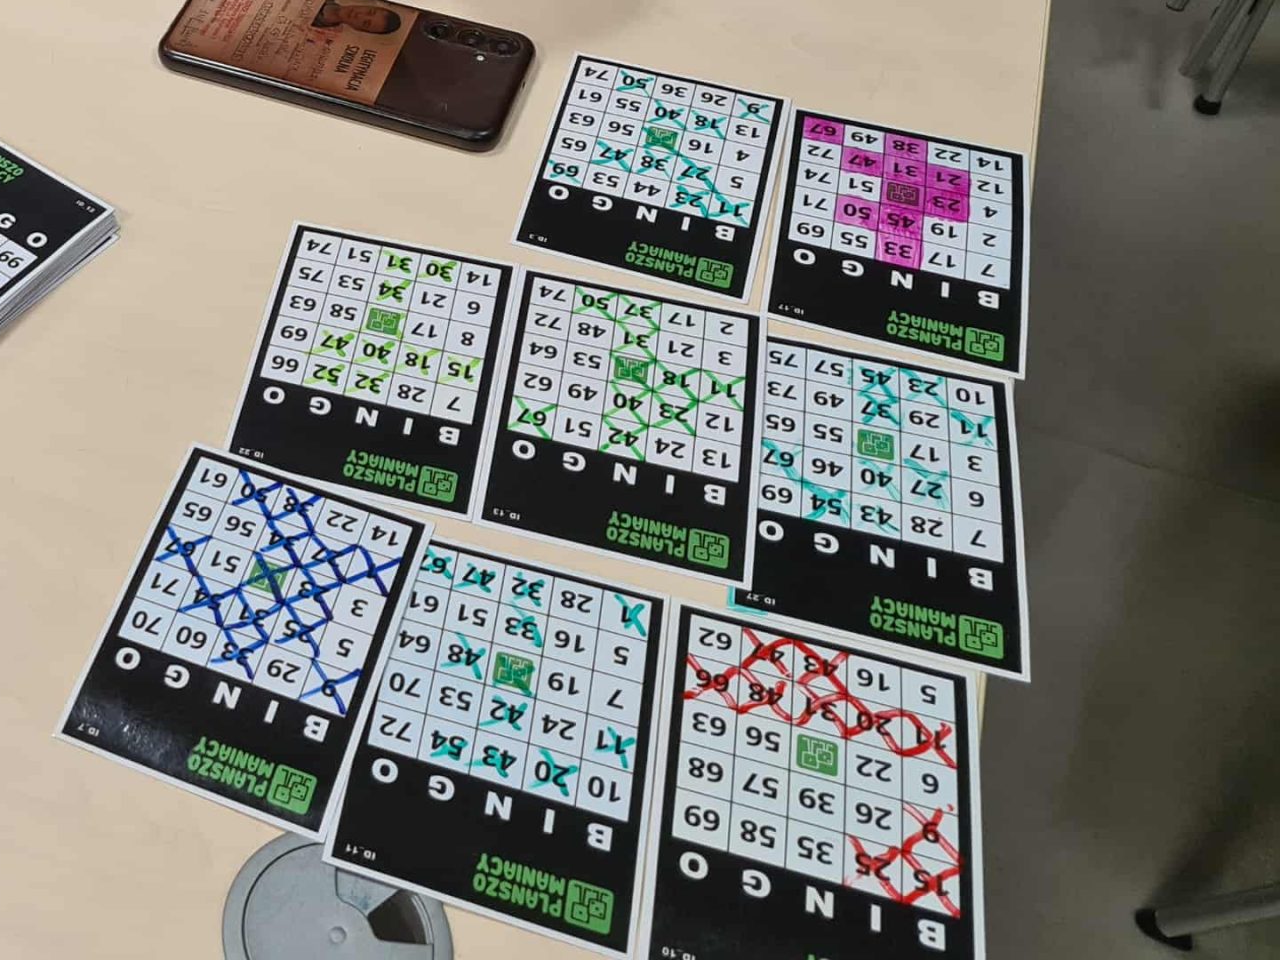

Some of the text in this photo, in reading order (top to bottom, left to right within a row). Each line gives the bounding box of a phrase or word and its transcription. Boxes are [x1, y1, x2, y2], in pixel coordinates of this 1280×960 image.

[334, 44, 360, 73] SZKOLNA
[344, 49, 378, 91] LEGITYMACJA
[585, 67, 727, 106] 26 36 74
[569, 113, 634, 136] 56 63
[810, 124, 1003, 170] 14 22 38 49 67
[593, 172, 661, 196] 44 53
[625, 251, 694, 277] PLANSZO
[628, 241, 697, 265] MANIACY
[797, 223, 994, 277] 7 17 33 55 69
[281, 326, 307, 341] 69
[290, 296, 474, 346] 8 17 58 63
[535, 313, 732, 365] 3 21 48 72
[886, 324, 962, 351] PLANSZO
[888, 310, 963, 337] MANIACY
[272, 356, 460, 411] 7 28 66
[815, 360, 985, 405] 10 57
[565, 418, 730, 468] 13 24 51
[910, 445, 982, 472] 3 17
[343, 463, 416, 491] PLANSZO
[347, 450, 419, 478] MANIACY
[183, 502, 256, 537] 56 65
[327, 510, 398, 546] 14 22
[608, 511, 687, 541] MANIACY
[762, 485, 986, 547] 7 28 69
[606, 527, 685, 557] PLANSZO
[410, 591, 584, 652] 16 51 61
[870, 612, 956, 645] PLANSZO
[871, 595, 956, 628] MANIACY
[132, 611, 300, 683] 29 60 70
[700, 628, 732, 650] 62
[399, 630, 623, 709] 7 19 64
[192, 736, 275, 779] MANIACY
[380, 715, 620, 802] 10 72
[693, 712, 938, 794] 6 22 56 63
[187, 753, 268, 798] PLANSZO
[689, 758, 891, 830] 26 39 57 68
[685, 806, 833, 864] 35 58 69
[475, 853, 566, 894] MANIACY
[472, 874, 562, 915] PLANSZO
